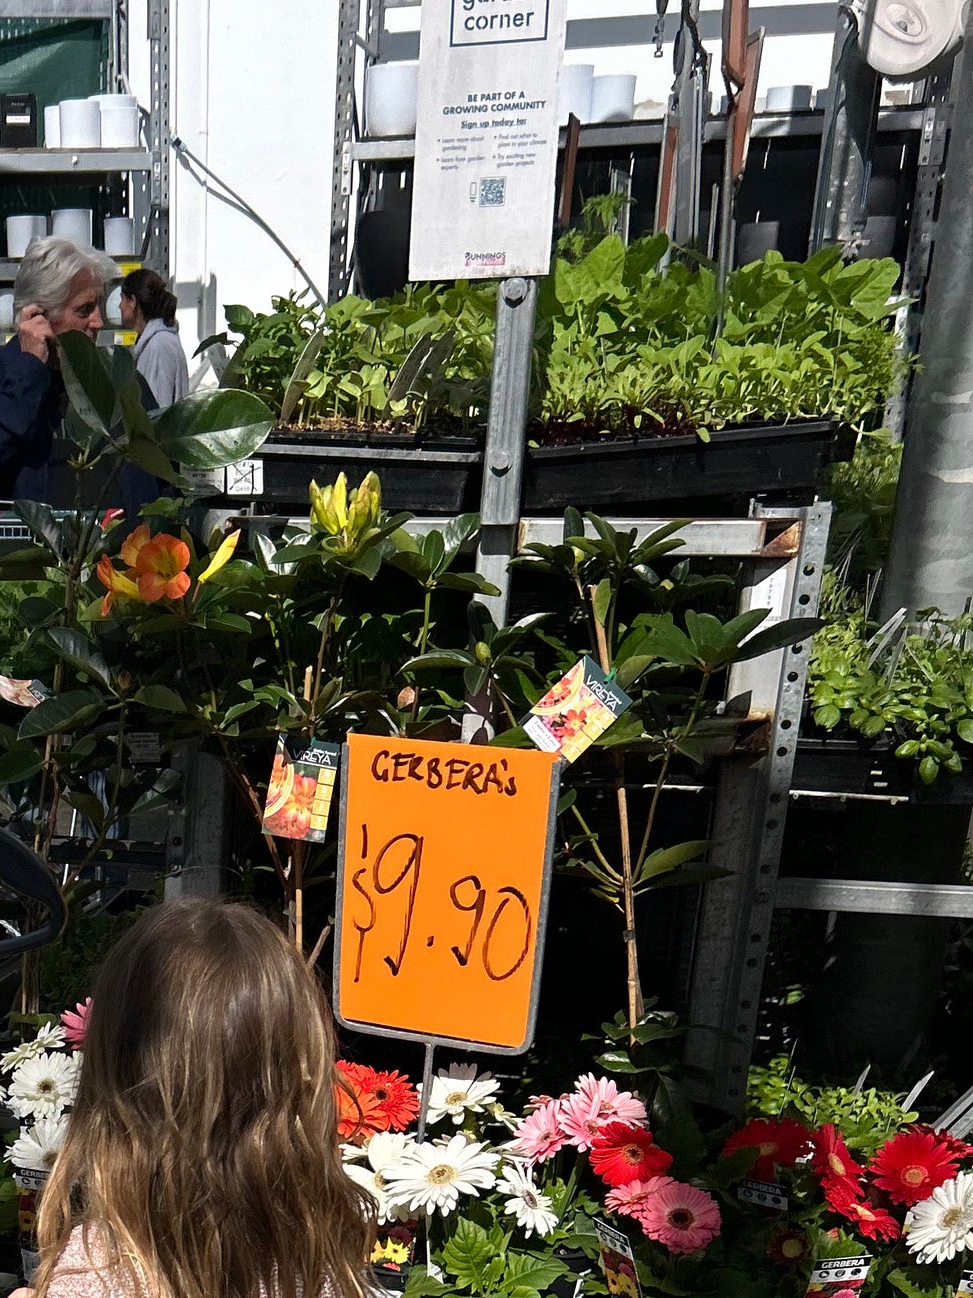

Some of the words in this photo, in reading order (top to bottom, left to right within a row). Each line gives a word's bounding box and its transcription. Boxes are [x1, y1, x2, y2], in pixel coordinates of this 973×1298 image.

[464, 12, 534, 31] corner
[467, 94, 477, 102] BE
[480, 92, 502, 101] PART
[504, 91, 516, 100] OF
[518, 91, 525, 99] A
[443, 104, 488, 115] GROWING
[490, 100, 546, 112] COMMUNITY
[460, 120, 477, 129] Sign
[479, 120, 489, 129] up
[491, 118, 514, 128] today
[587, 674, 619, 712] VIREYA
[351, 823, 532, 983] $9.90
[821, 1258, 865, 1269] GERBERA
